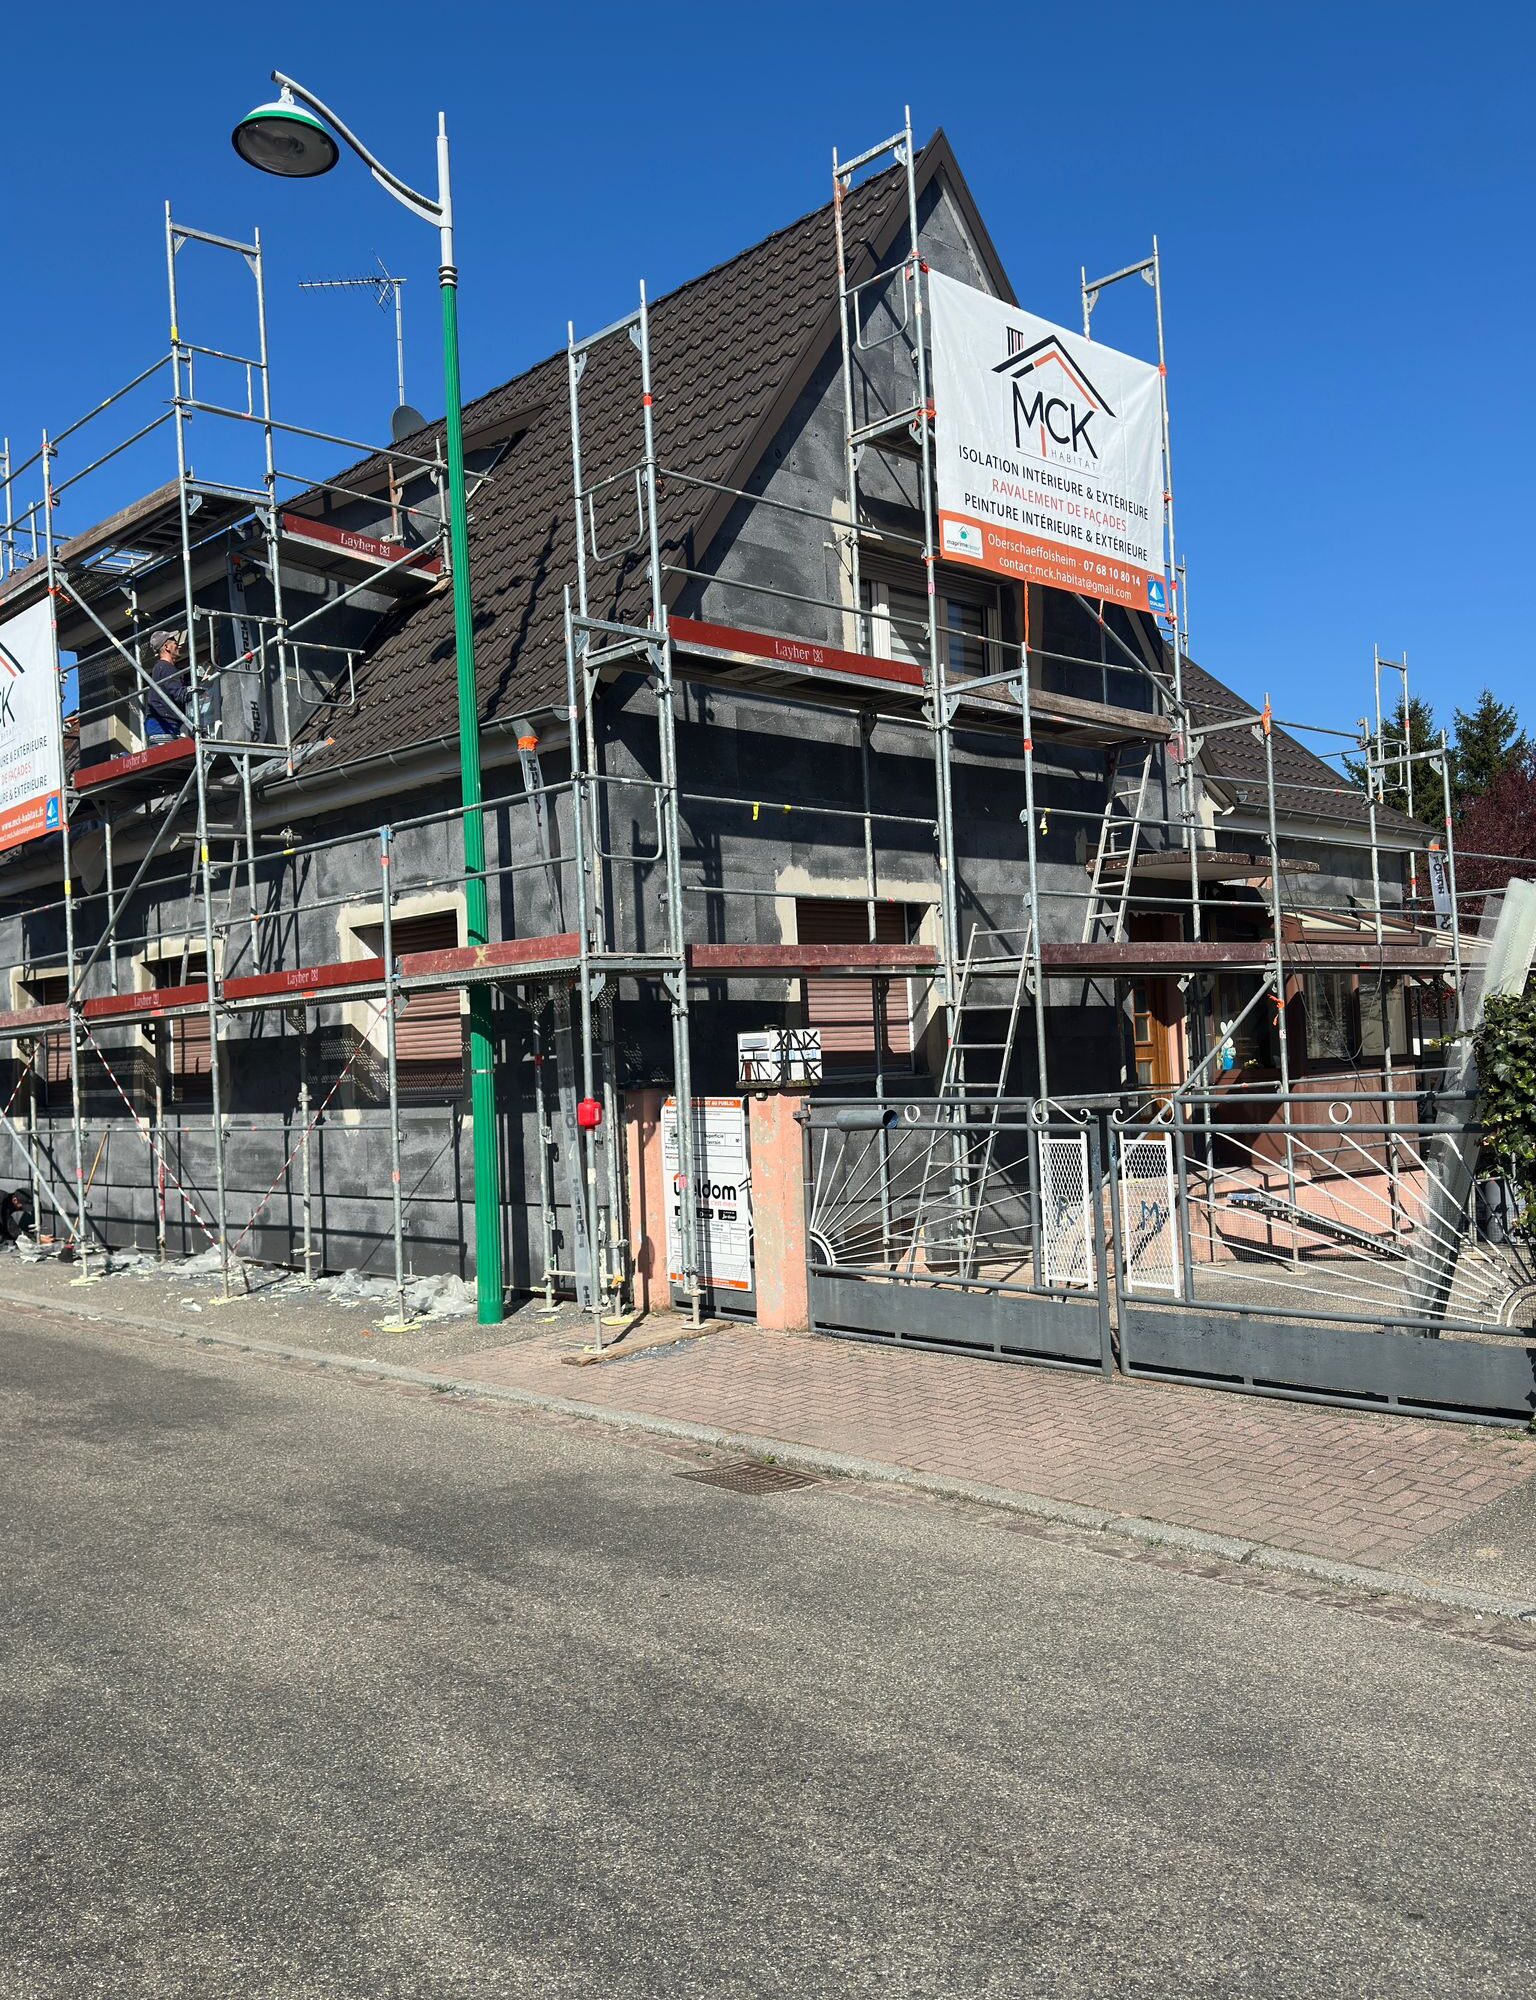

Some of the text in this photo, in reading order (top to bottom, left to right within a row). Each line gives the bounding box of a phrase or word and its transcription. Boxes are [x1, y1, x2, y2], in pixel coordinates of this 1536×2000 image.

[1012, 381, 1099, 460] MCK
[959, 444, 1149, 521] ISOLATION INTÉRIEURE & EXTÉRIEURE
[1051, 449, 1097, 471] HABITAT
[964, 492, 1148, 562] PEINTURE INTÉRIEURE & EXTÉRIEURE
[992, 478, 1127, 532] RAVALEMENT DE FAÇADES
[340, 532, 377, 553] Layher
[988, 533, 1077, 568] Oberschaeffolsheim
[1083, 559, 1095, 573] 07
[1095, 563, 1107, 576] 68
[1108, 567, 1119, 580] 10
[1120, 570, 1130, 583] 80
[1131, 574, 1141, 587] 14
[999, 556, 1132, 601] contact.mck.habitat@gmail.com
[775, 641, 811, 660] Layher
[287, 970, 310, 987] Layher
[673, 1179, 737, 1201] ldom
